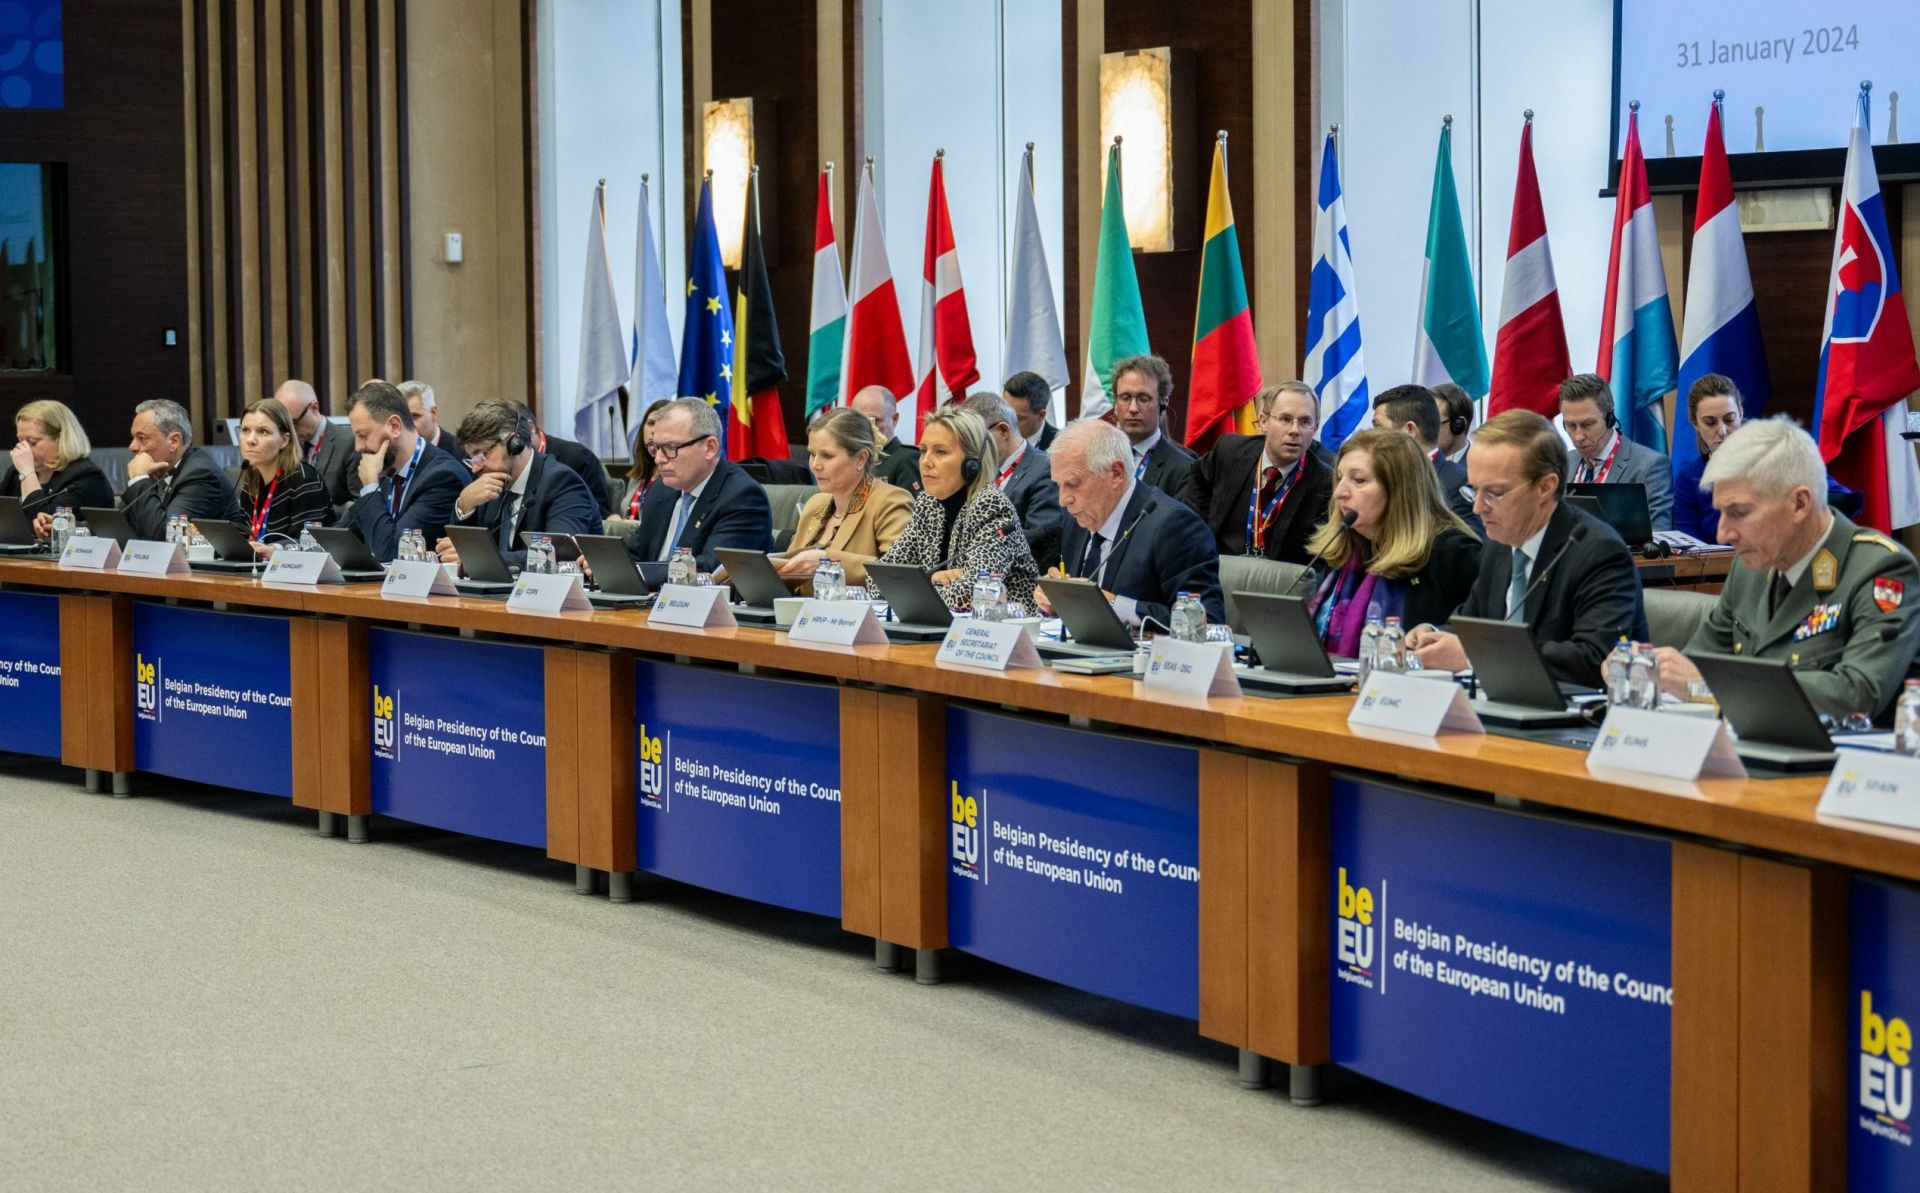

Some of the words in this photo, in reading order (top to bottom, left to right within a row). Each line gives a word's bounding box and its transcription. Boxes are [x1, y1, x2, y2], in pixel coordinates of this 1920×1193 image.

[1677, 41, 1702, 68] 31
[1708, 37, 1795, 64] January
[1802, 24, 1860, 56] 2024
[668, 599, 690, 608] BELGIUM
[960, 638, 998, 649] SECRETARIAT
[965, 628, 991, 638] GENERAL
[14, 660, 24, 671] of
[24, 660, 38, 673] the
[137, 653, 155, 685] be
[955, 649, 964, 657] OF
[975, 652, 999, 662] COUNCIL
[137, 683, 155, 710] EU
[165, 678, 193, 695] Belgian
[195, 683, 240, 703] Presidency
[242, 690, 251, 702] of
[252, 691, 267, 704] the
[165, 696, 173, 707] of
[173, 697, 185, 710] the
[187, 700, 221, 716] European
[223, 705, 247, 719] Union
[374, 685, 394, 720] be
[374, 717, 394, 747] EU
[404, 713, 435, 732] Belgian
[437, 718, 487, 742] Presidency
[489, 727, 500, 740] of
[501, 728, 518, 743] the
[640, 724, 662, 764] be
[404, 732, 414, 745] of
[414, 734, 427, 748] the
[428, 736, 467, 755] European
[468, 743, 496, 760] Union
[640, 760, 662, 796] EU
[675, 757, 710, 779] Belgian
[713, 764, 772, 793] Presidency
[774, 777, 787, 792] of
[787, 779, 807, 796] the
[674, 780, 685, 794] of
[684, 781, 700, 798] the
[701, 785, 746, 808] European
[748, 794, 780, 815] Union
[952, 780, 978, 828] be
[952, 822, 979, 865] EU
[993, 820, 1036, 847] Belgian
[1039, 832, 1112, 868] Presidency
[1114, 850, 1129, 869] of
[1131, 852, 1155, 874] the
[993, 848, 1005, 864] of
[1005, 850, 1024, 870] the
[1026, 855, 1081, 885] European
[1083, 869, 1122, 894] Union
[1338, 867, 1374, 926] be
[1338, 918, 1374, 969] EU
[1394, 917, 1451, 953] Belgian
[1455, 934, 1552, 983] Presidency
[1555, 960, 1576, 984] of
[1577, 963, 1610, 992] the
[1393, 950, 1411, 970] of
[1410, 953, 1434, 979] the
[1437, 960, 1511, 1001] European
[1514, 981, 1565, 1016] Union
[1860, 990, 1912, 1066] be
[1860, 1053, 1912, 1120] EU
